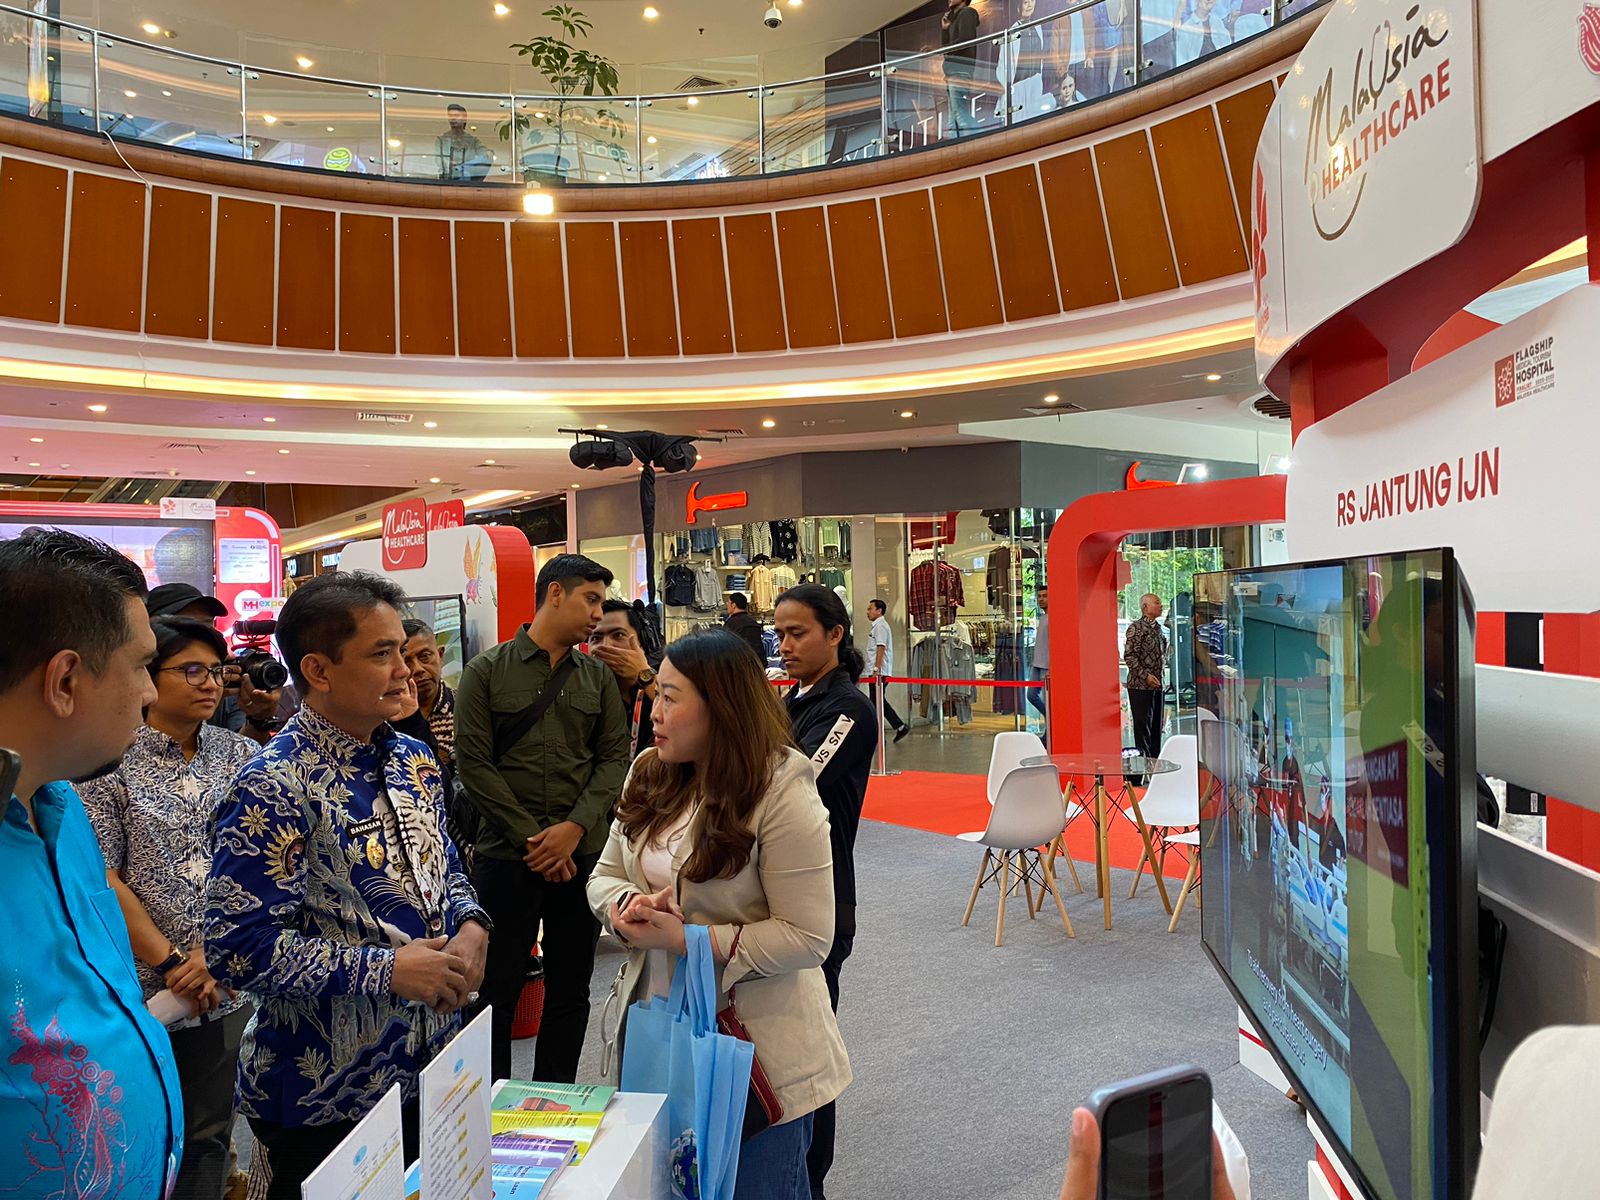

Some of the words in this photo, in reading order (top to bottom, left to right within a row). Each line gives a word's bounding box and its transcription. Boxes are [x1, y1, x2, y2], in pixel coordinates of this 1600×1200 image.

[1322, 58, 1450, 199] HEALTHCARE
[1515, 336, 1554, 363] FLAGSHIP
[1516, 359, 1554, 384] HOSPITAL
[1338, 489, 1356, 527] RS
[1360, 462, 1452, 522] JANTUNG
[1458, 446, 1499, 503] IJN
[390, 533, 424, 549] HEALTHCARE
[1260, 968, 1278, 1005] recovery
[1290, 1003, 1304, 1038] heart
[1304, 1026, 1328, 1071] surgery
